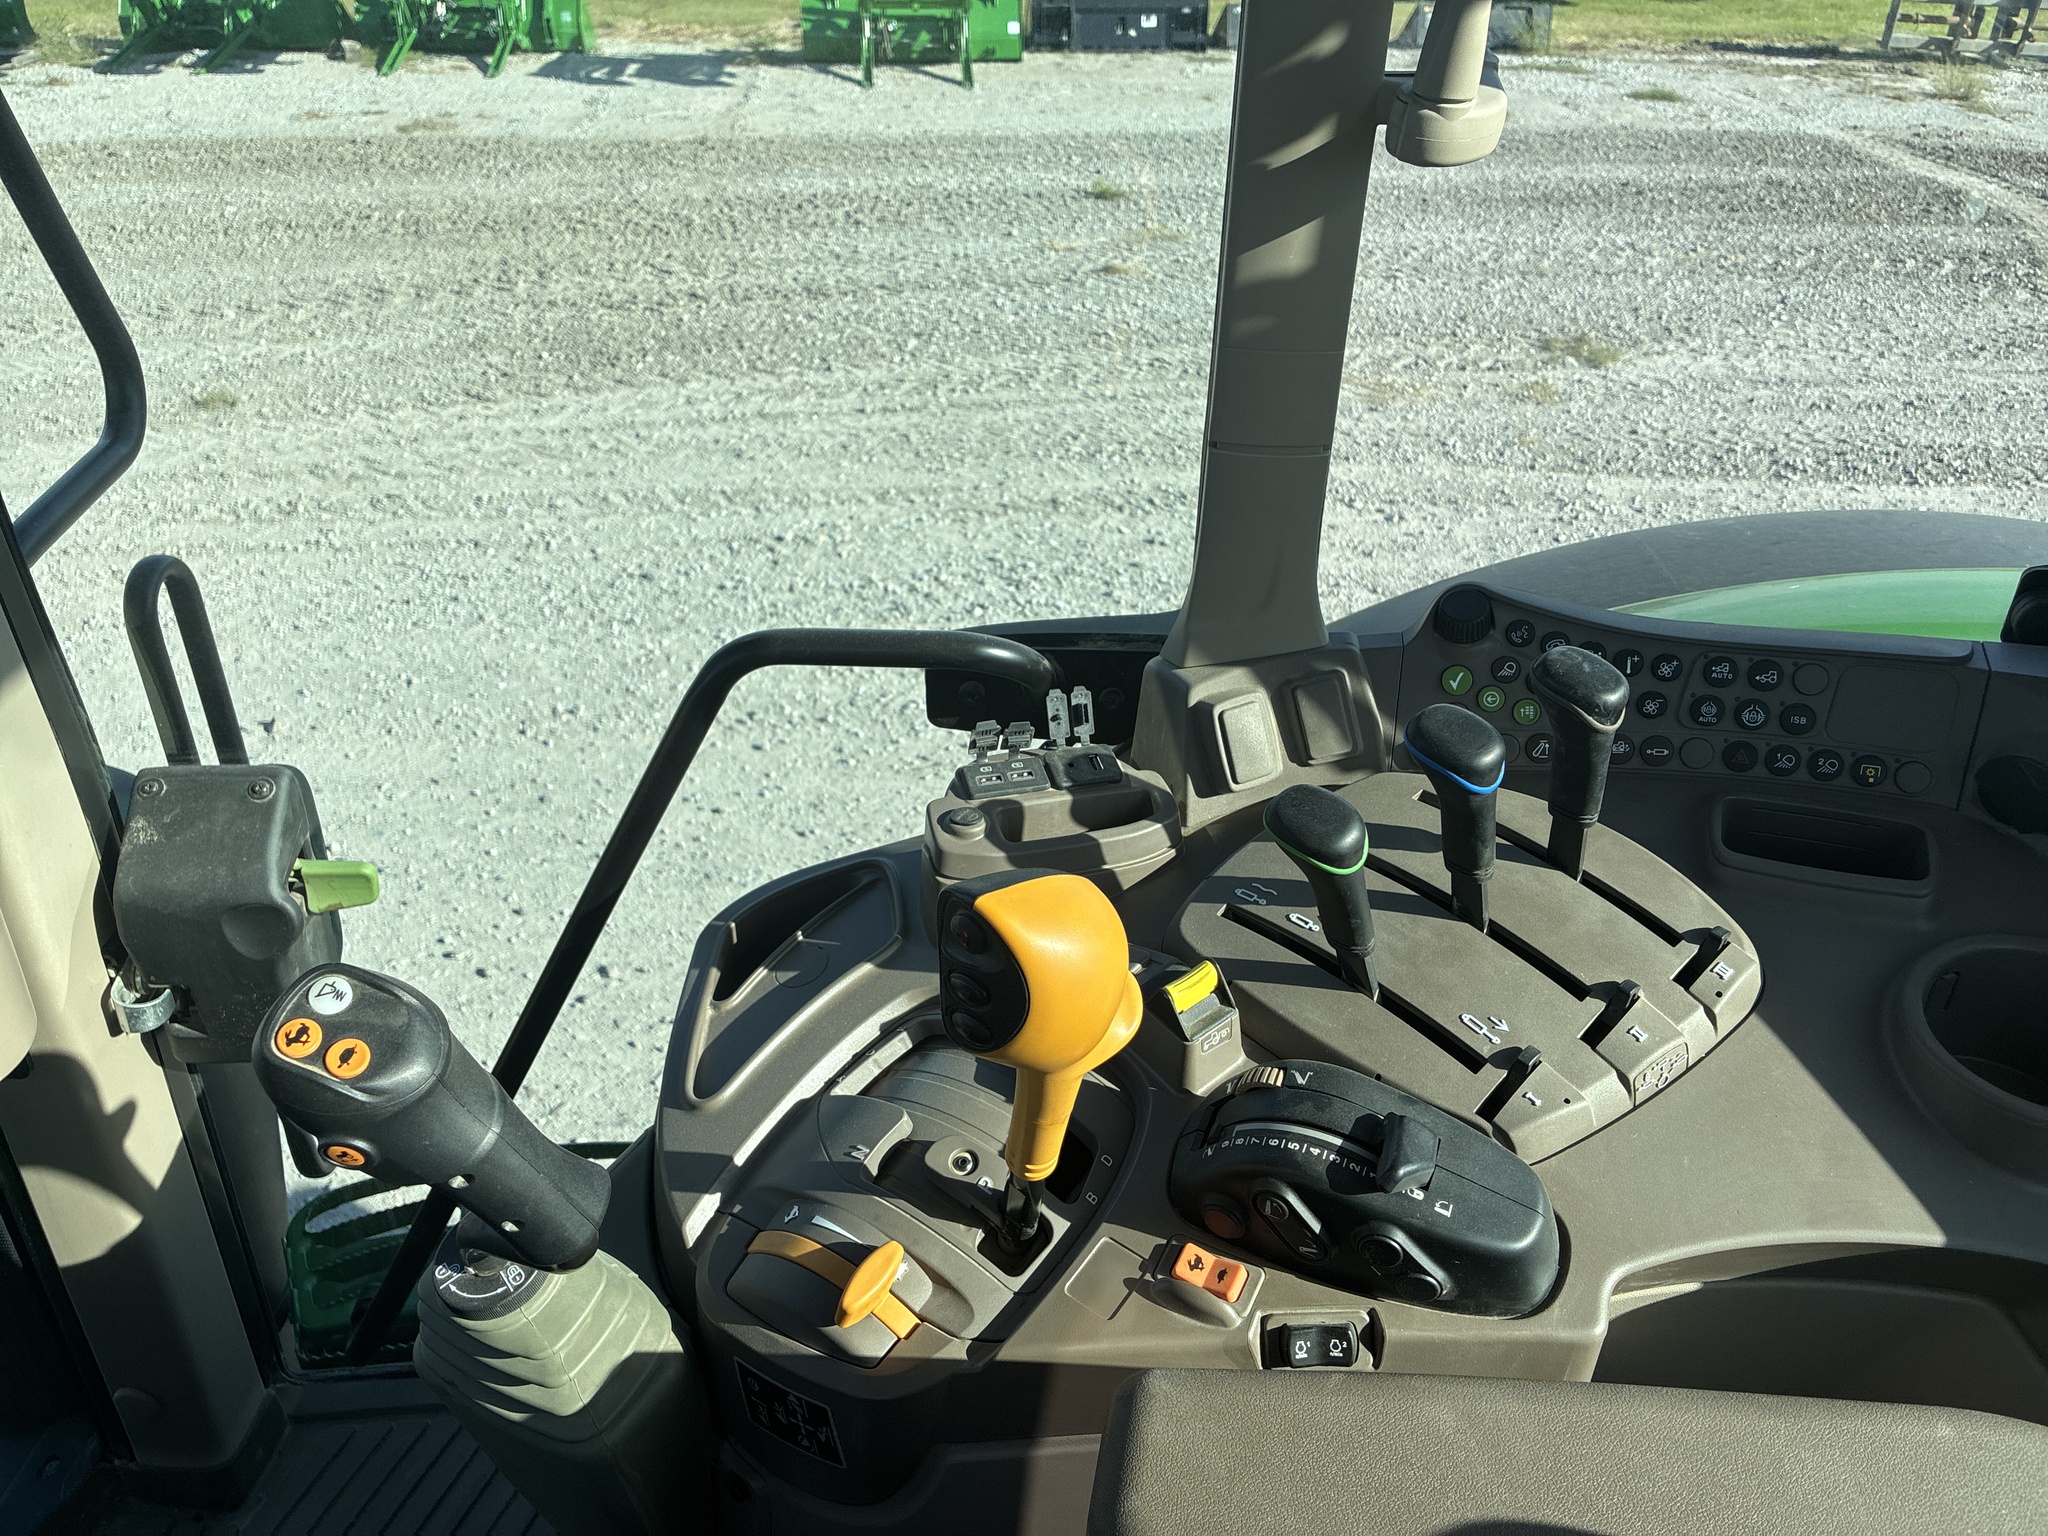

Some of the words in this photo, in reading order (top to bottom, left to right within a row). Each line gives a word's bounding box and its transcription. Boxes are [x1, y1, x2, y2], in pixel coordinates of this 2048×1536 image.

[1711, 672, 1733, 680] AUTO
[1790, 715, 1807, 725] ISB
[1818, 757, 1825, 766] 2
[1712, 961, 1734, 981] III
[1628, 1024, 1649, 1043] II
[1100, 1154, 1113, 1167] D
[1235, 1137, 1245, 1145] 8
[1250, 1137, 1261, 1145] 7
[1268, 1138, 1279, 1147] 6
[1287, 1141, 1300, 1150] 5
[1309, 1145, 1321, 1156] 4
[1329, 1153, 1341, 1164] 3
[1350, 1162, 1361, 1173] 2
[977, 1176, 994, 1195] P
[1085, 1191, 1098, 1205] B
